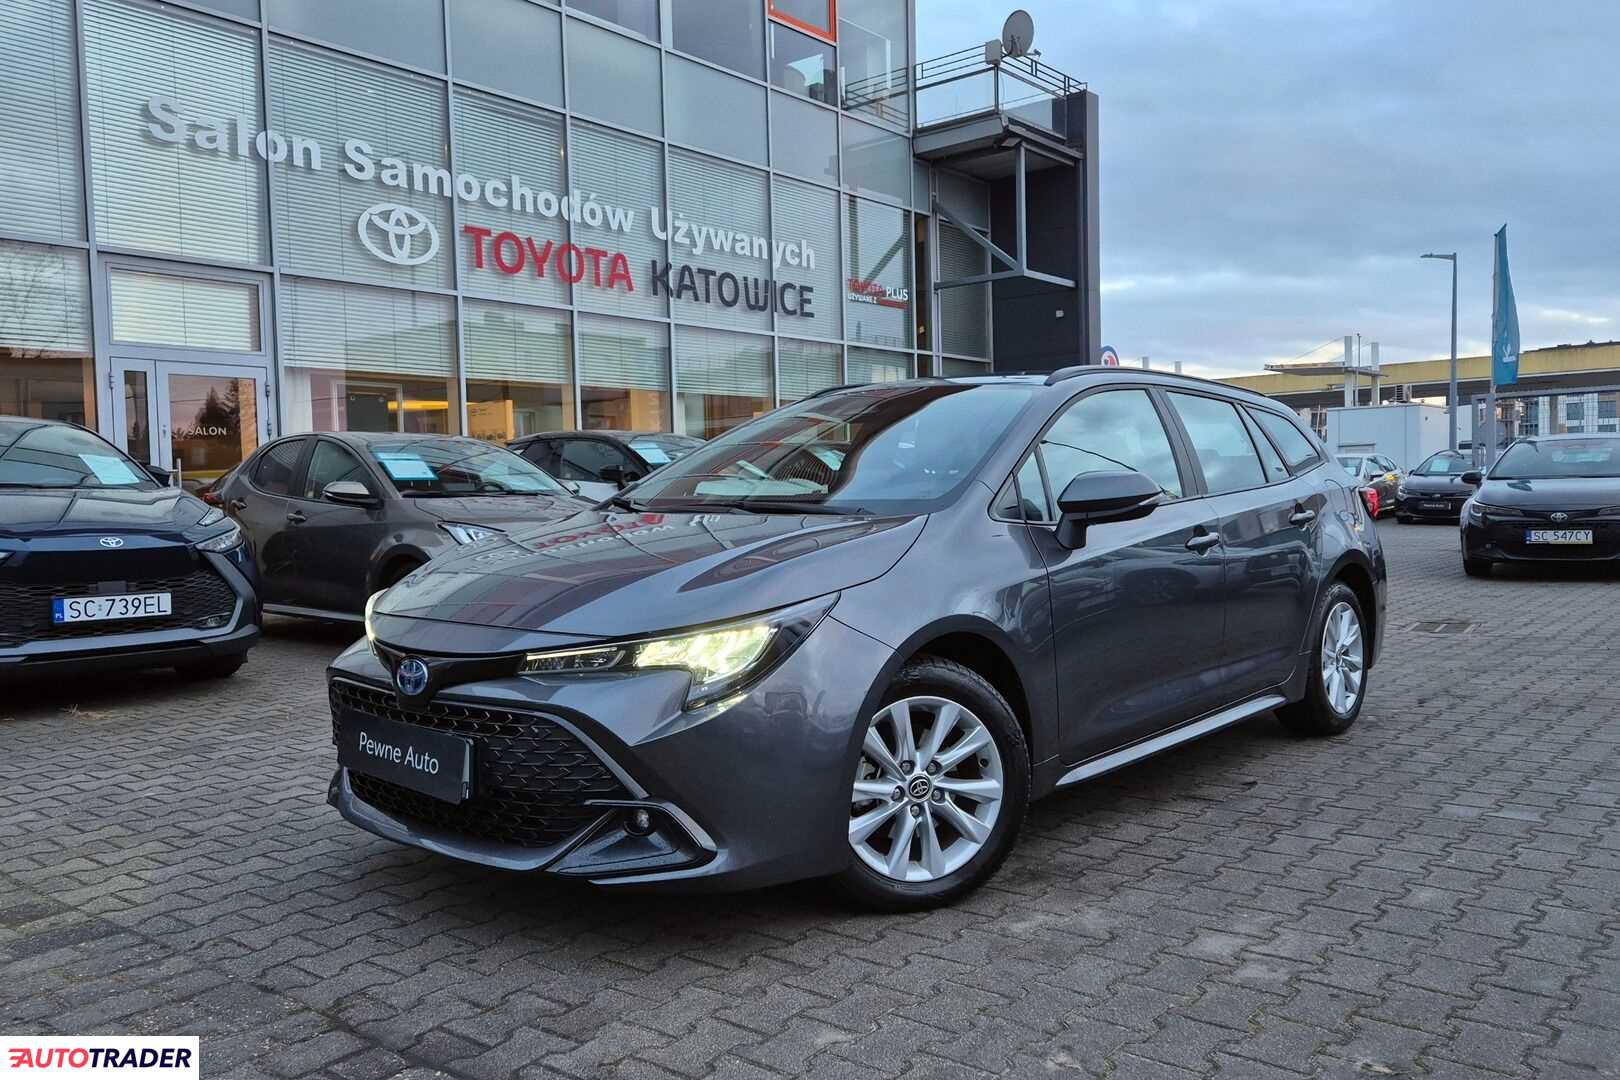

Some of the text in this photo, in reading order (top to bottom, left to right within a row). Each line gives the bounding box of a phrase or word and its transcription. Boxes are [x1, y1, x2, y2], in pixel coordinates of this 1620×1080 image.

[148, 95, 815, 271] Salon Samochodów Używanych
[463, 225, 815, 318] TOYOTA KATOWICE
[886, 286, 909, 300] PLUS
[1534, 531, 1590, 541] SC 547CY
[69, 596, 168, 619] SC 739EL
[359, 731, 440, 775] Pewne Auto
